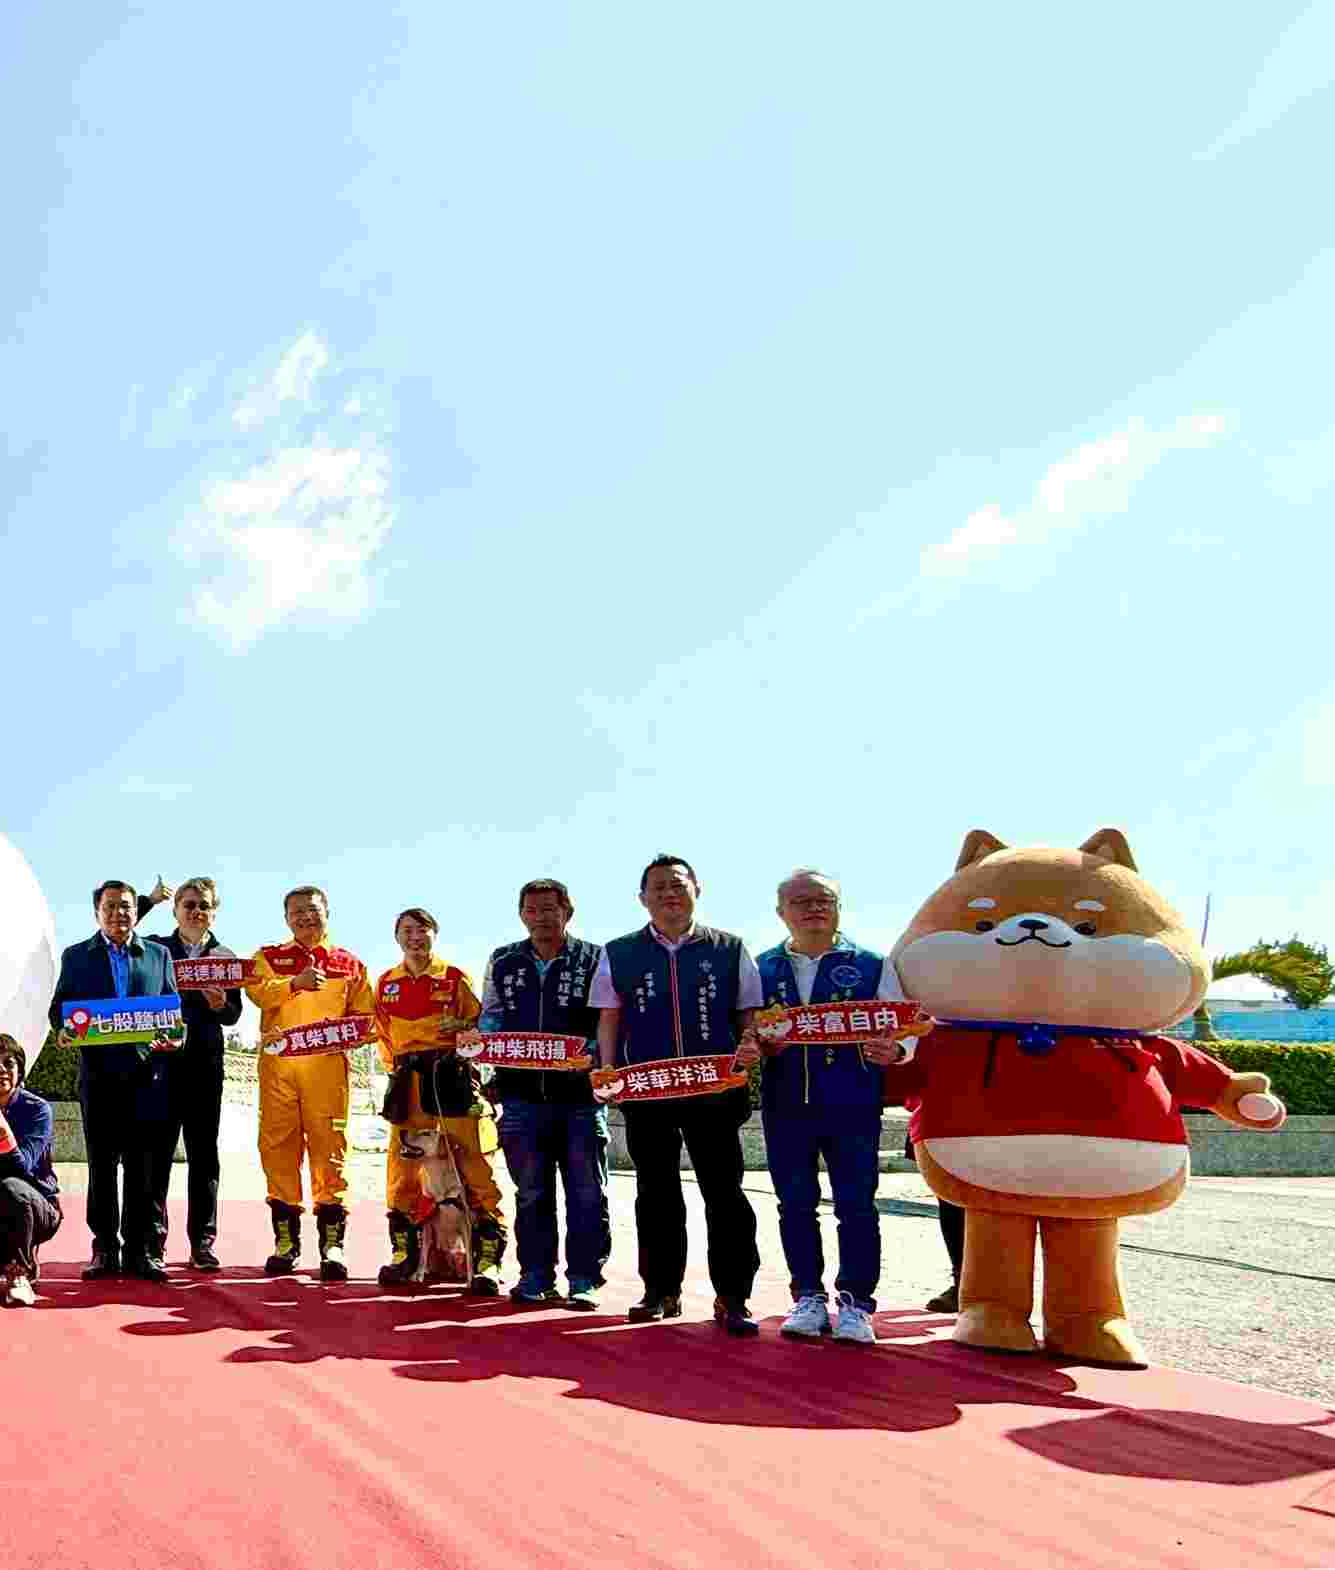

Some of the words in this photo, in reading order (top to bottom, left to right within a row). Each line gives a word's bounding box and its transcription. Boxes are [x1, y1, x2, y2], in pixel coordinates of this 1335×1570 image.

[796, 1008, 899, 1034] 柴富自由
[487, 1039, 565, 1060] 神柴飛揚
[626, 1061, 719, 1092] 柴華洋溢
